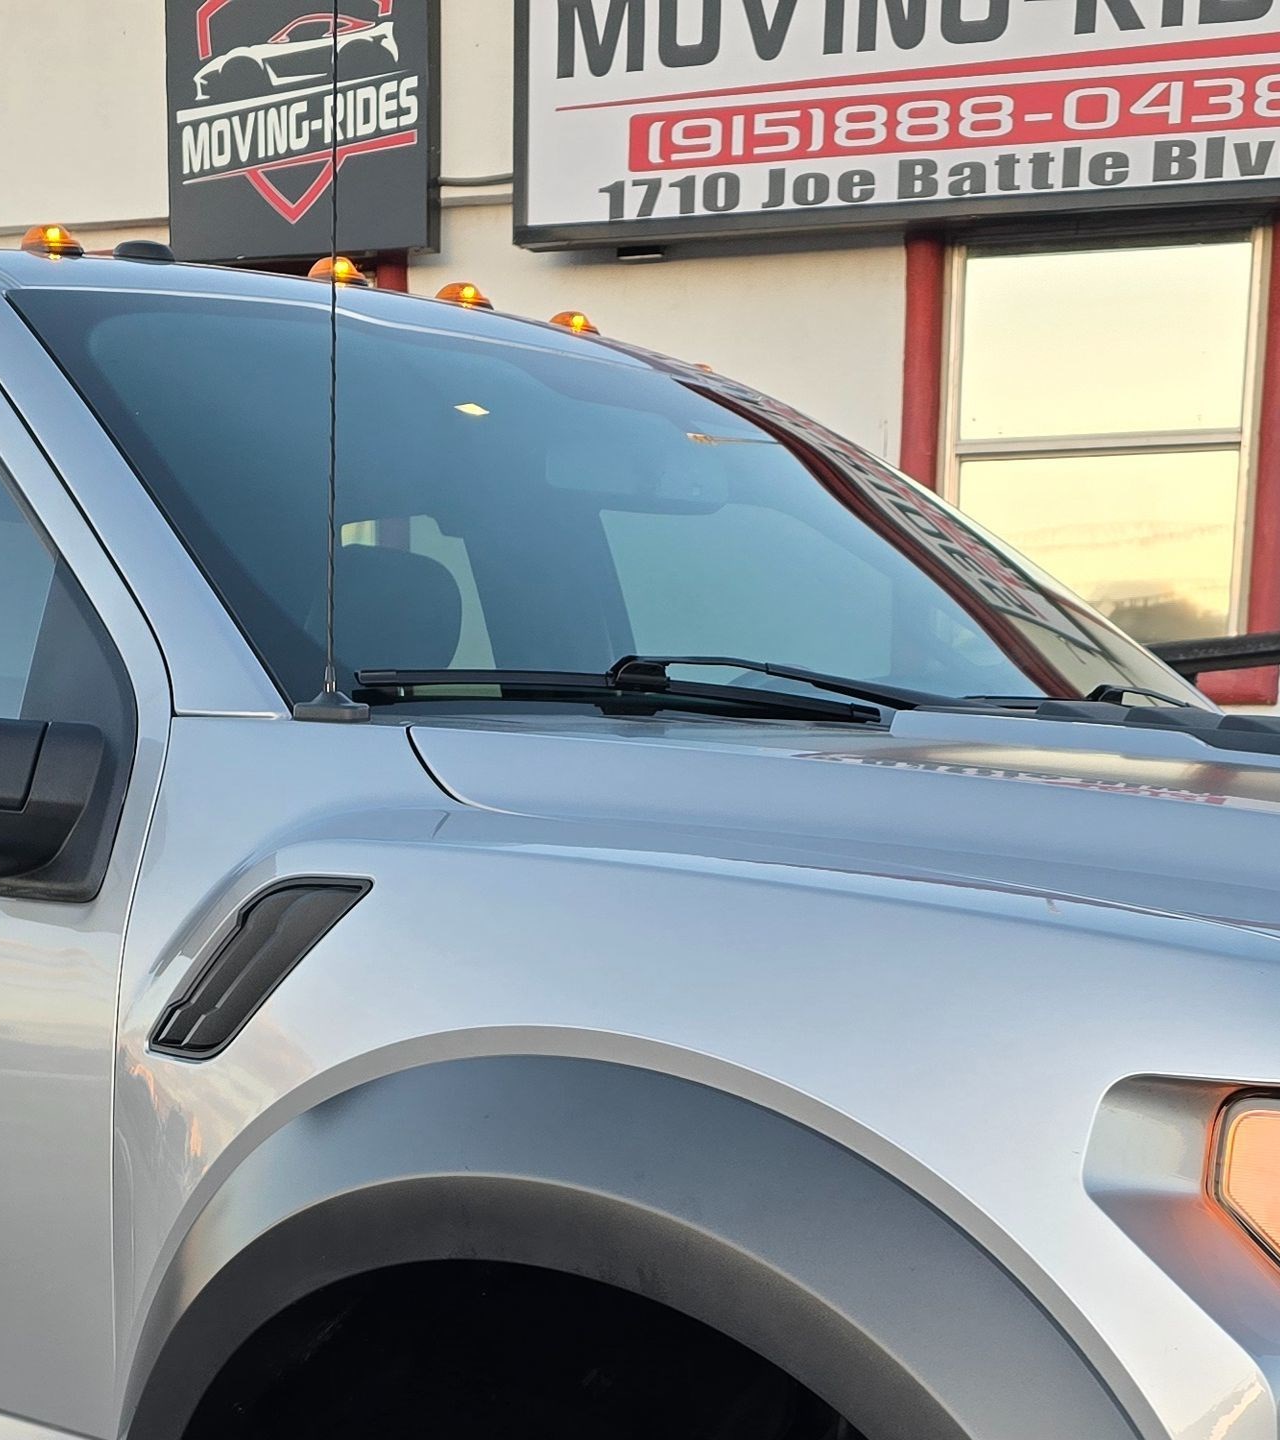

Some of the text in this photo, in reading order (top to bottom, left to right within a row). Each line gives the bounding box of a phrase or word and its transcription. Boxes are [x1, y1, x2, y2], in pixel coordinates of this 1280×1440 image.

[182, 75, 418, 175] MOVING-RIDES
[598, 170, 741, 222] 1710
[761, 167, 876, 209] Joe
[897, 146, 1129, 200] Battle
